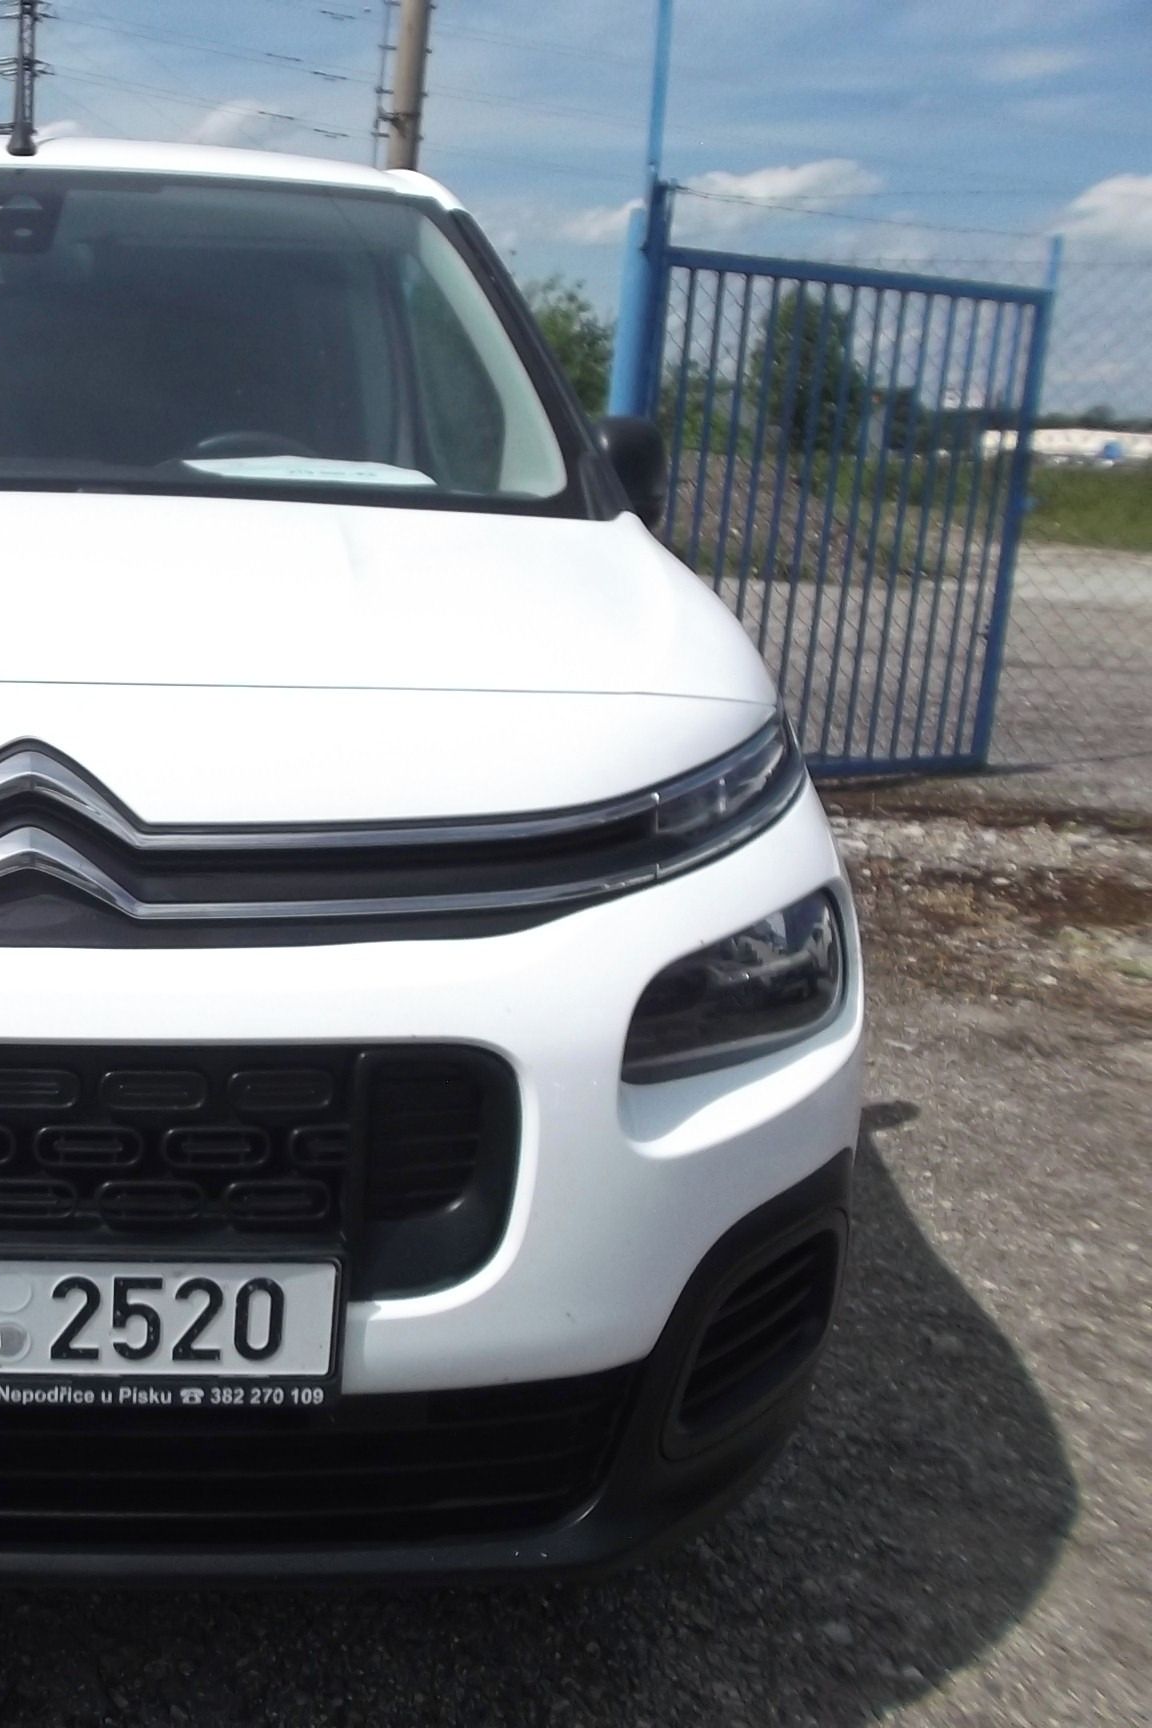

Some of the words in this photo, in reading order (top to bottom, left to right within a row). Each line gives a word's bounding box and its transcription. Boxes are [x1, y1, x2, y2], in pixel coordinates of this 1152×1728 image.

[50, 1276, 285, 1361] 2520
[101, 1389, 112, 1403] u
[210, 1387, 244, 1404] 382
[250, 1387, 284, 1404] 270
[290, 1387, 324, 1404] 109
